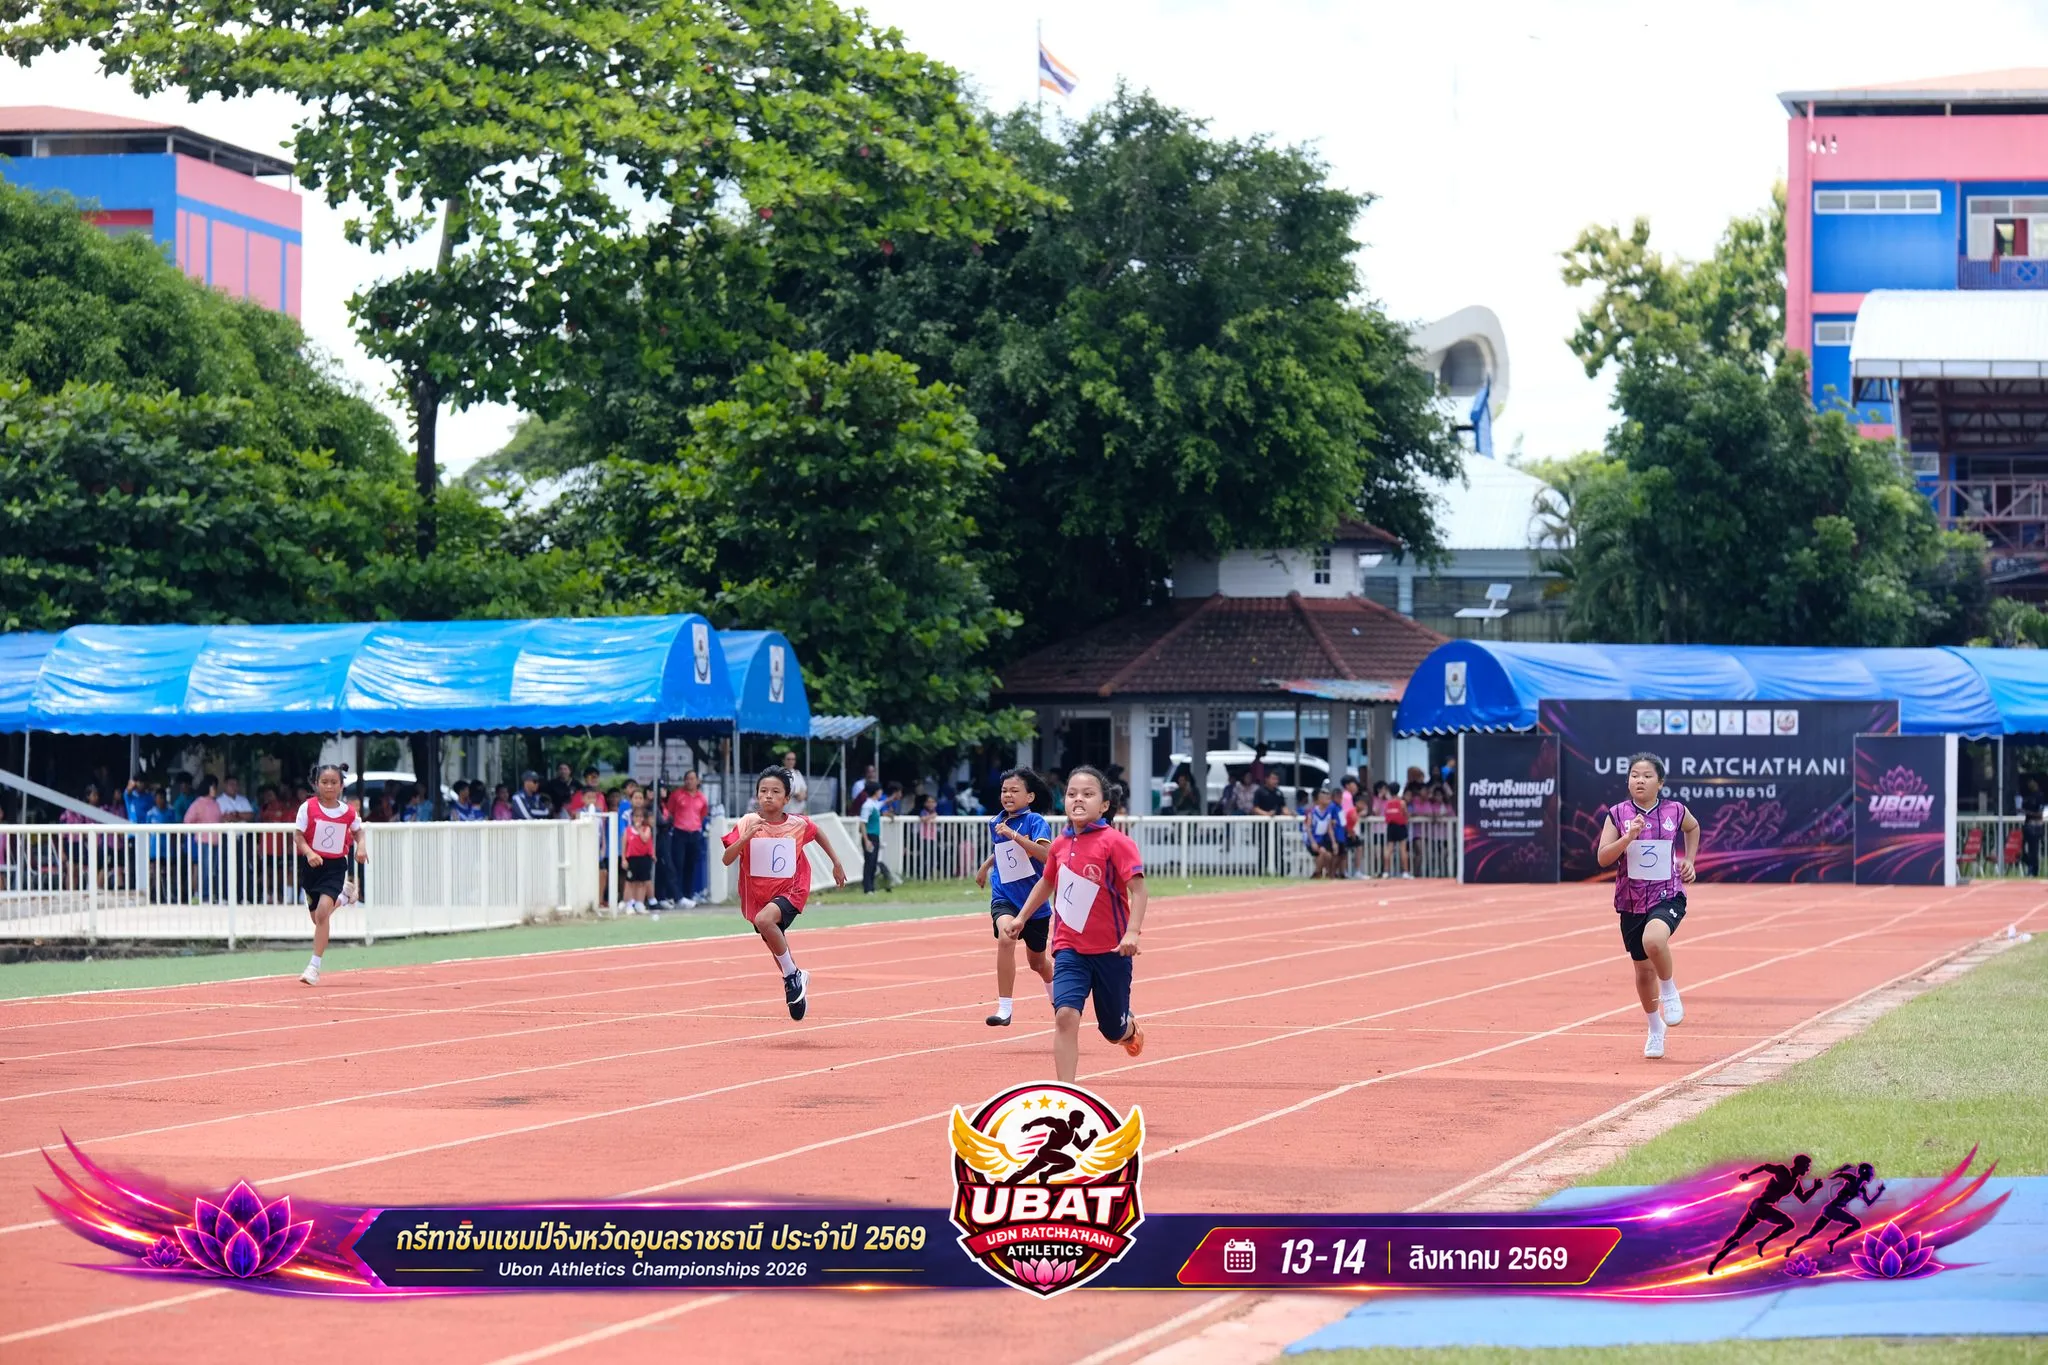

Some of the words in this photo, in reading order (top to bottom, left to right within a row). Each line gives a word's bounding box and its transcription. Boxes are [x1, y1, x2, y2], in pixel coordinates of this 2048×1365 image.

[1594, 757, 1670, 775] UBN
[1682, 757, 1846, 775] RATCHATHANI
[1868, 795, 1935, 812] UBON
[321, 825, 335, 849] 8
[771, 844, 786, 873] 6
[1005, 848, 1018, 869] 5
[1639, 845, 1659, 868] 3
